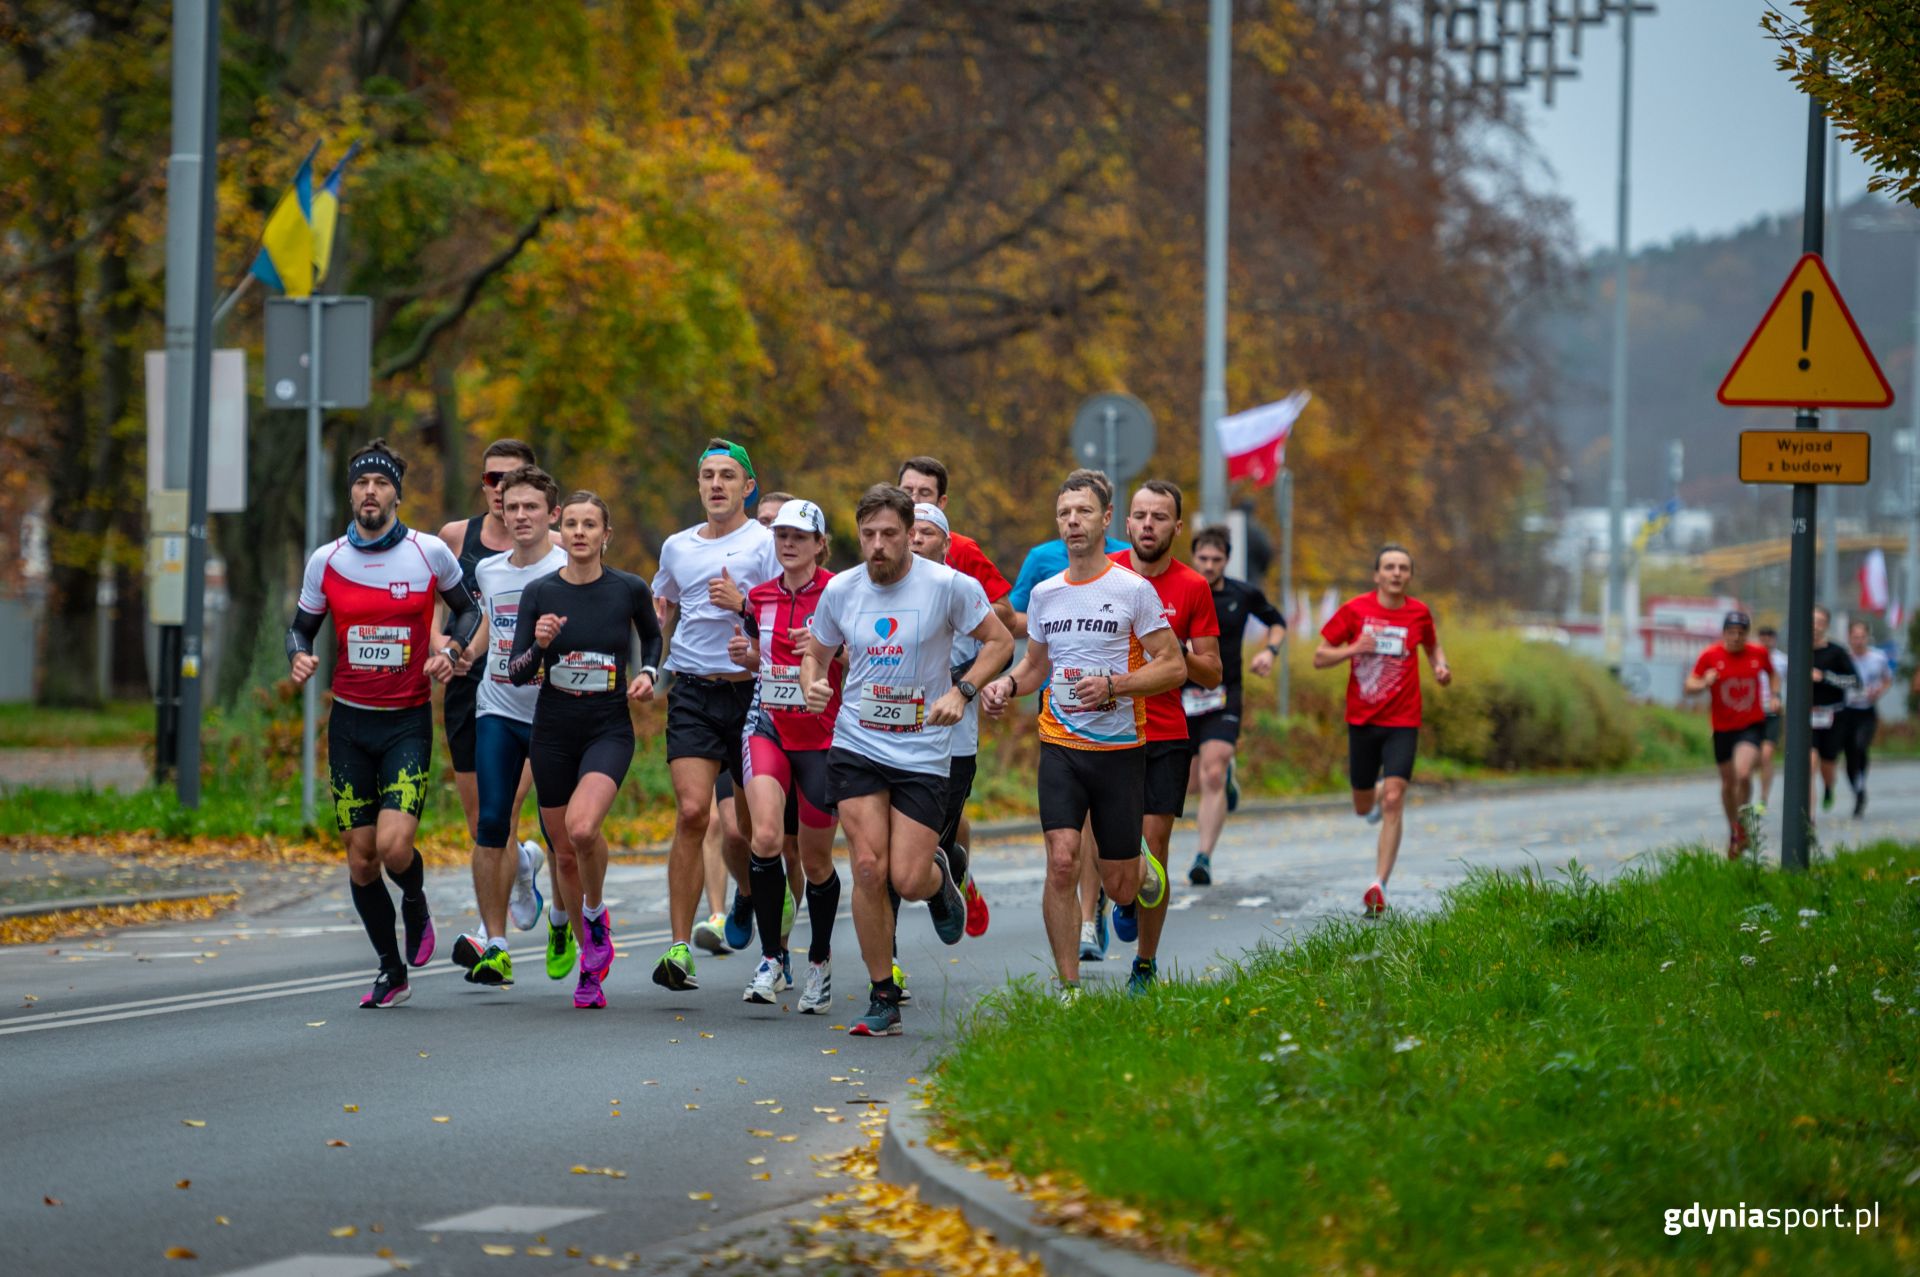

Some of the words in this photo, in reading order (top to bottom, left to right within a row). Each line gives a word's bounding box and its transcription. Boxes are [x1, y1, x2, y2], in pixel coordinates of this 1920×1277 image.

[1777, 438, 1833, 454] Wyjazd
[1767, 462, 1774, 471] z
[1782, 460, 1842, 476] budowy
[359, 626, 377, 637] BIEG
[1044, 618, 1072, 635] MAJA
[1076, 618, 1119, 634] TEAM
[359, 646, 390, 660] 1019
[867, 645, 904, 656] ULTRA
[499, 658, 509, 671] 6
[869, 656, 901, 666] KREW
[570, 672, 589, 684] 77
[1064, 668, 1081, 679] BIEG
[774, 686, 797, 699] 727
[873, 685, 893, 695] BIEG
[873, 705, 902, 719] 226
